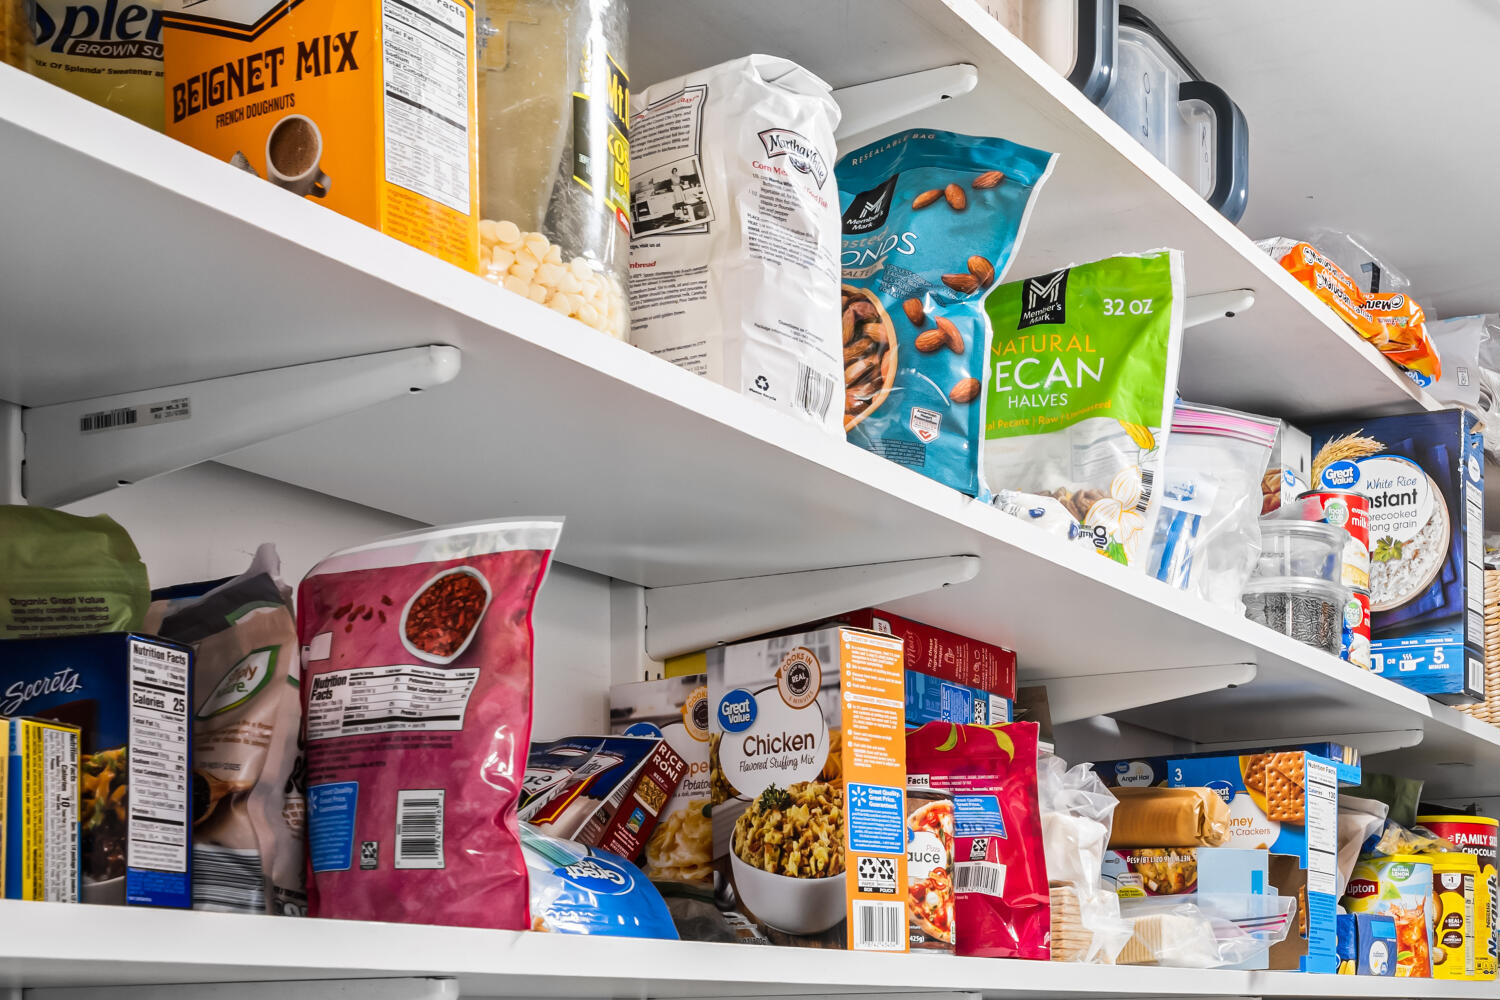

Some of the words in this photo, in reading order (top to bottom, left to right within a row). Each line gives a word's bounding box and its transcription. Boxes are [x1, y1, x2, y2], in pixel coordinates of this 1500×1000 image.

[76, 44, 138, 56] BROWN
[172, 48, 286, 124] BEIGNET
[294, 30, 360, 84] MIX
[215, 99, 244, 129] FRENCH
[245, 92, 296, 122] DOUGHNUTS
[752, 159, 772, 174] Corn
[852, 222, 873, 231] Mark
[1023, 302, 1062, 320] Member's
[1103, 299, 1124, 316] 32
[1129, 299, 1153, 315] OZ
[1029, 314, 1050, 324] Mark
[1008, 393, 1068, 408] HALVES
[1325, 466, 1354, 481] Great
[1366, 478, 1393, 490] White
[1397, 476, 1417, 487] Rice
[1369, 522, 1390, 533] long
[1393, 519, 1417, 531] grain
[133, 643, 165, 663] Nutrition
[167, 651, 186, 665] Facts
[1433, 647, 1445, 664] 5
[312, 674, 347, 691] Nutrition
[4, 667, 82, 716] Secrets
[311, 688, 333, 701] Facts
[132, 691, 165, 709] Calories
[173, 697, 186, 712] 25
[722, 699, 750, 716] Great
[728, 712, 750, 724] Value
[743, 732, 815, 757] Chicken
[658, 743, 684, 772] RICE
[740, 758, 768, 772] Flavored
[770, 756, 798, 771] Stuffing
[801, 755, 815, 765] Mix
[907, 776, 928, 785] Facts
[1174, 768, 1182, 781] 3
[868, 788, 882, 796] Great
[1236, 828, 1271, 837] Crackers
[1454, 834, 1487, 846] FAMILY
[1488, 875, 1499, 958] Nesquik
